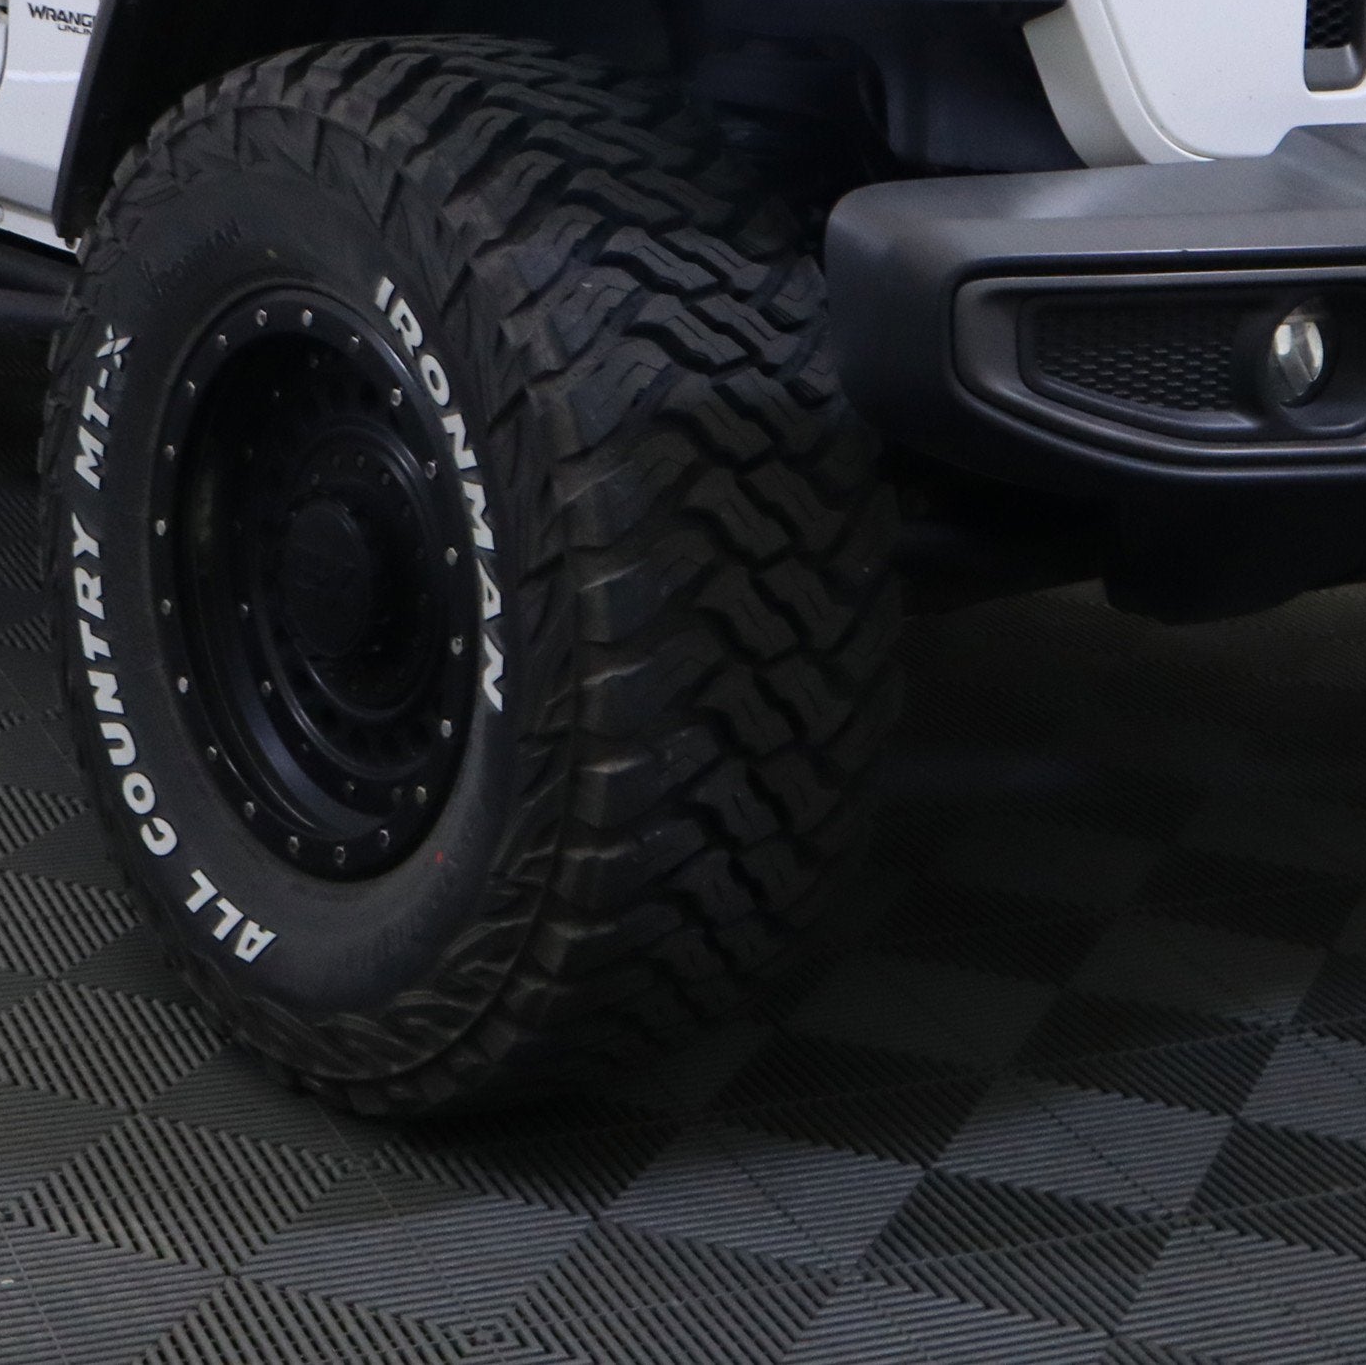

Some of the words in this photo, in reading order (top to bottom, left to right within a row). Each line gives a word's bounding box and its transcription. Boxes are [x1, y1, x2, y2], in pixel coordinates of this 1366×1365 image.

[27, 2, 97, 28] WRANG
[75, 325, 132, 490] MT-X
[375, 277, 504, 713] IRONMAN
[72, 512, 178, 857] COUNTRY
[184, 869, 278, 963] ALL
